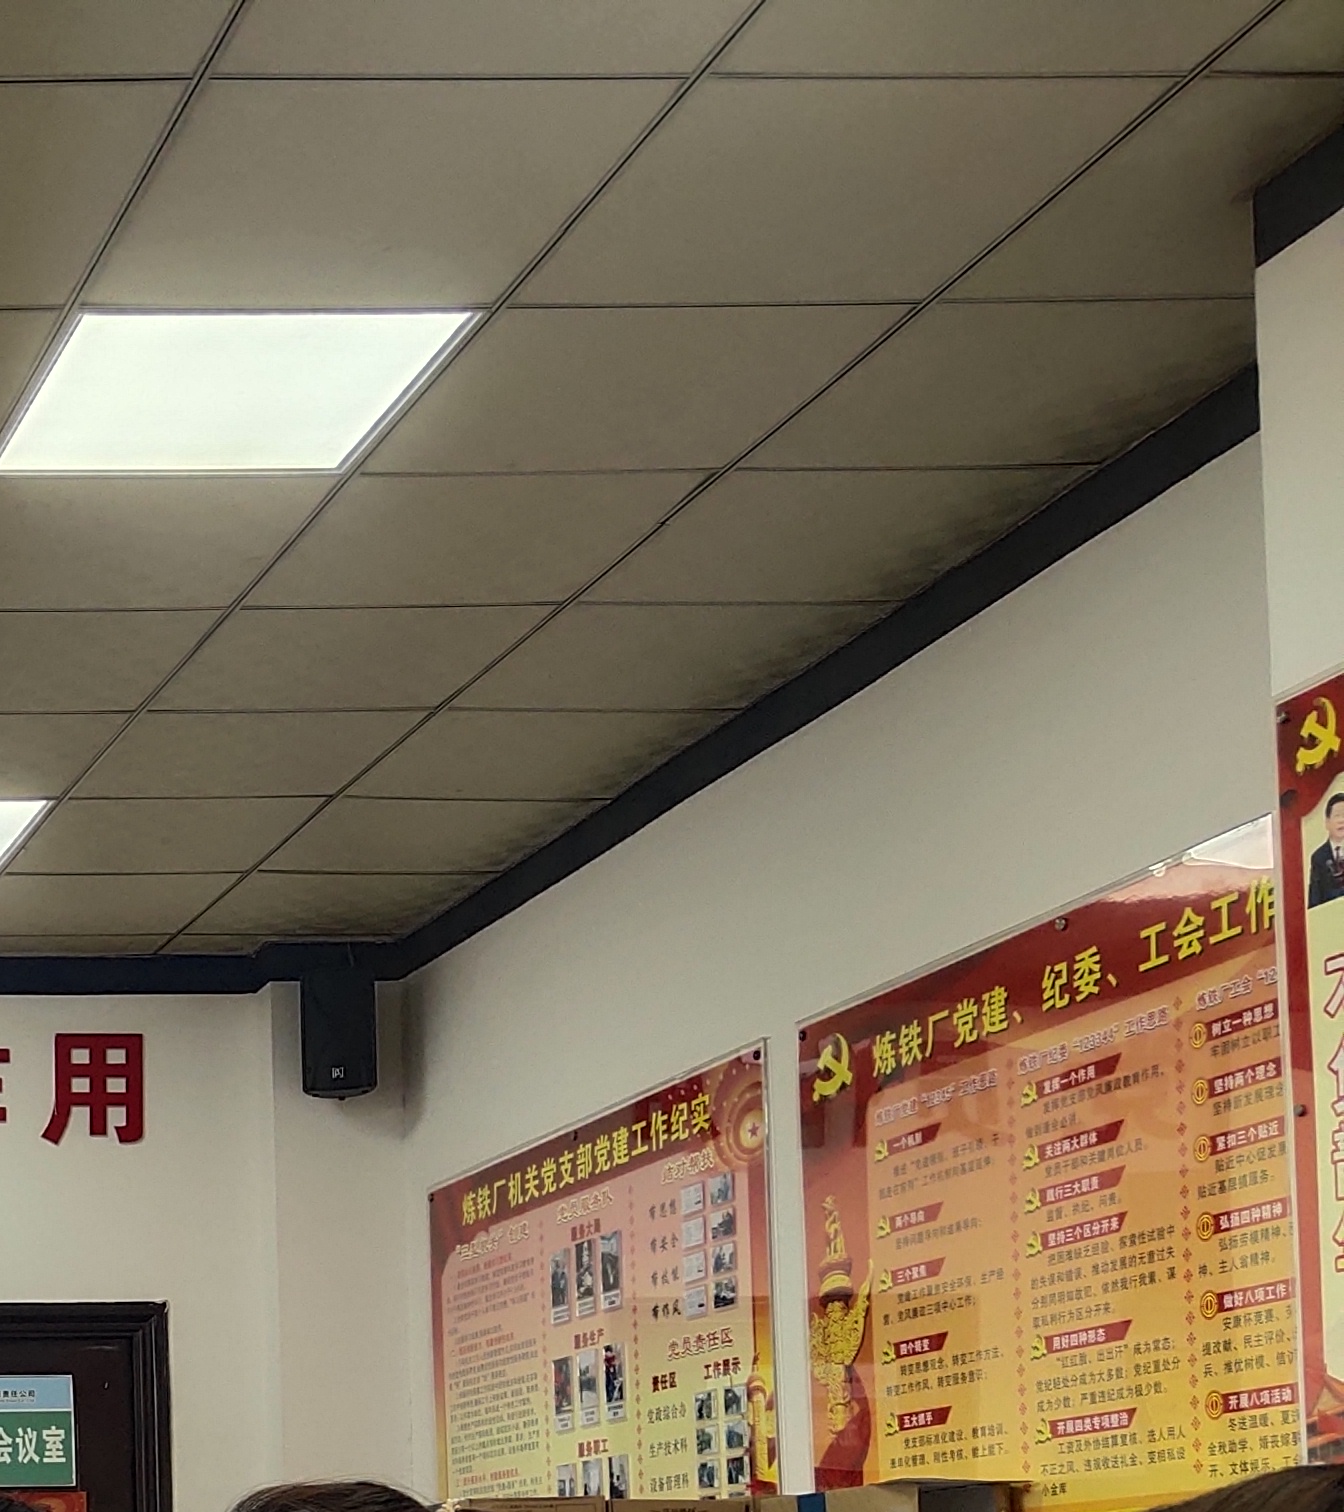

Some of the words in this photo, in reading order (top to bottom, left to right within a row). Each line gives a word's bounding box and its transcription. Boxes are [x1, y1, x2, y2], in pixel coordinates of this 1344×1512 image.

[1212, 1002, 1274, 1037] 树立一种思想
[1043, 1065, 1096, 1095] 发挥一个作用
[1214, 1062, 1277, 1094] 坚持两个理念
[1044, 1131, 1098, 1159] 关注两大群体
[1216, 1120, 1279, 1151] 紧扣三个贴近
[462, 1094, 711, 1226] 炼铁厂机关党支部党建工作纪实
[1046, 1176, 1099, 1202] 履行三大职责
[1219, 1202, 1282, 1230] 弘扬四种精神
[1048, 1217, 1119, 1247] 坚持三个区分开来
[1223, 1283, 1287, 1309] 做好八项工作
[573, 1328, 605, 1349] 服务生产
[667, 1327, 734, 1361] 党员责任区
[899, 1339, 930, 1356] 四个转变
[1052, 1328, 1106, 1350] 用好四种形态
[651, 1371, 677, 1393] 责任区
[703, 1357, 742, 1381] 工作展示
[1228, 1387, 1292, 1410] 开展八项活动
[1056, 1412, 1129, 1435] 开展四类专项整治
[1042, 1483, 1068, 1497] 小金库
